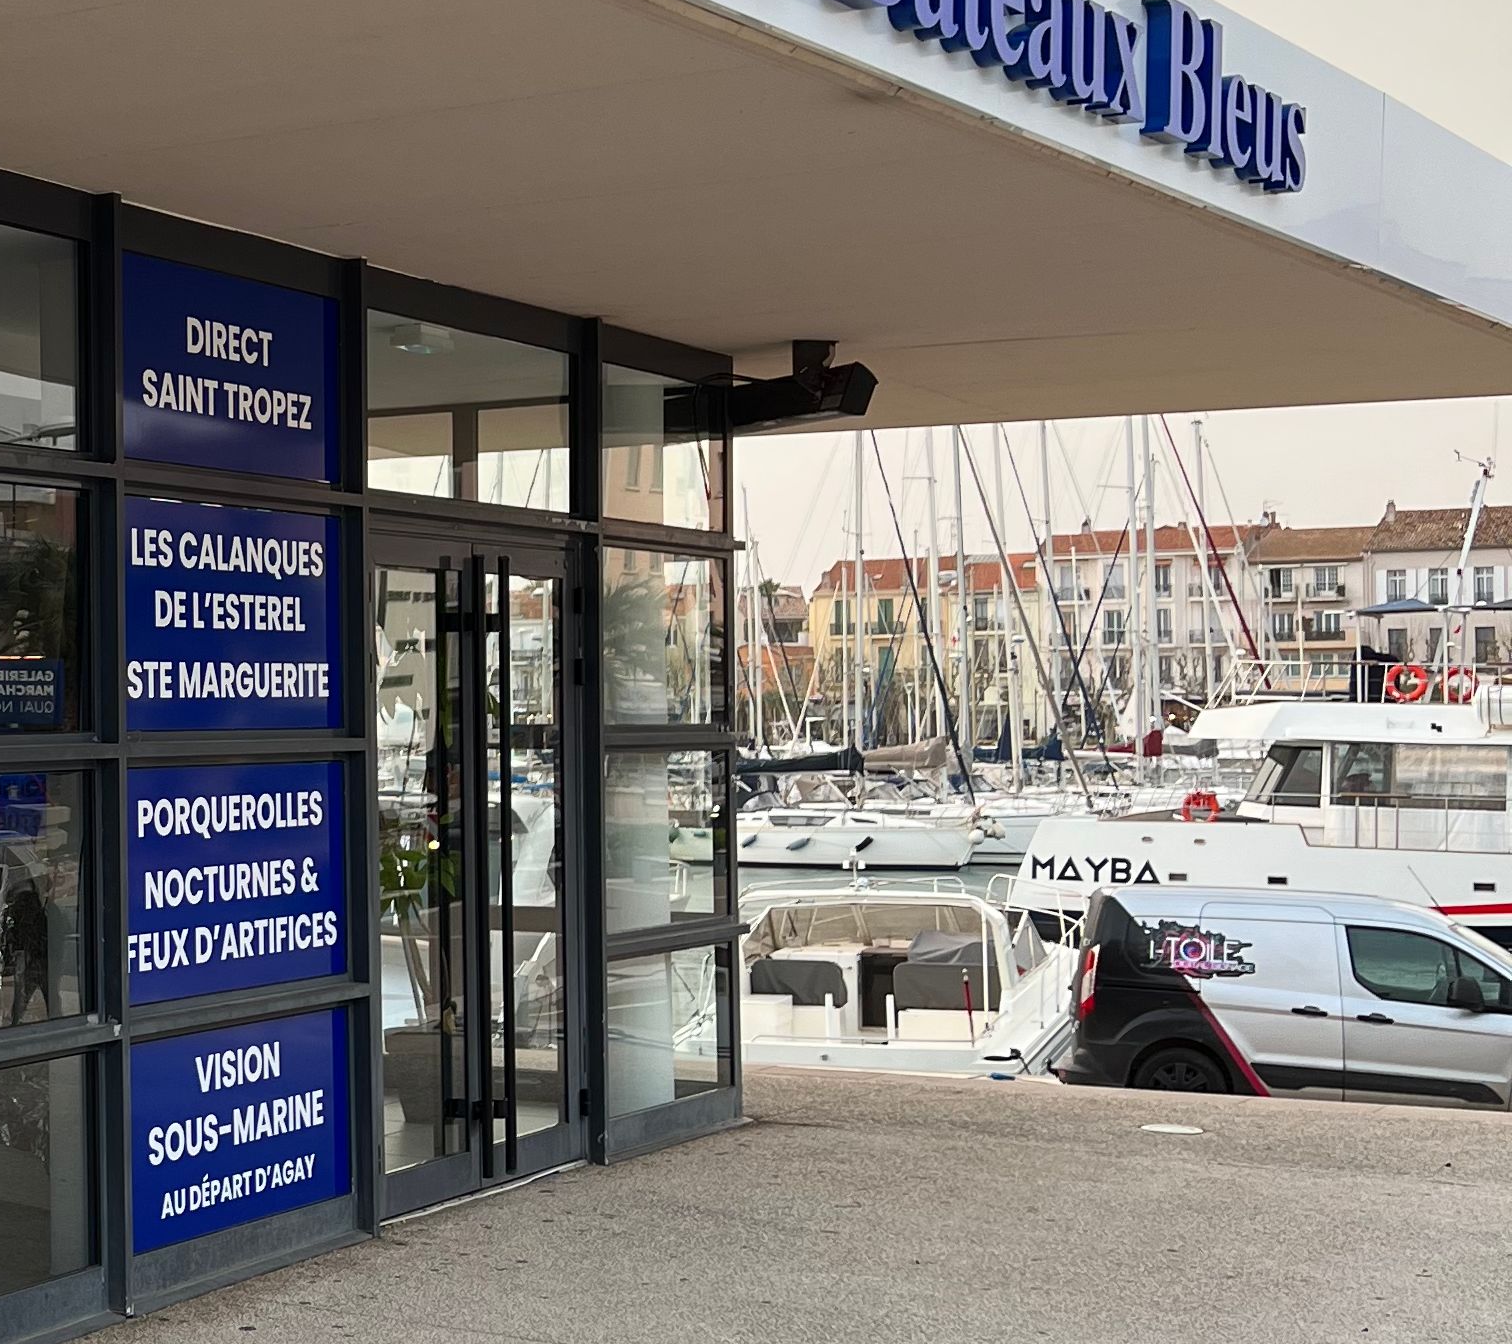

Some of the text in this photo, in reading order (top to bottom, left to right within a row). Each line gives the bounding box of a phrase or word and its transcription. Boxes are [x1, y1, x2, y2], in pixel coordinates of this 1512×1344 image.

[186, 316, 273, 367] DIRECT
[142, 369, 312, 430] SAINT TROPEZ
[131, 527, 323, 579] LES CALANQUES
[155, 590, 305, 632] DE L'ESTEREL
[127, 660, 329, 699] STE MARGUERITE
[137, 790, 323, 839] PORQUEROLLES
[144, 857, 319, 910] NOCTURNES &
[1031, 854, 1161, 885] MAYBA
[127, 911, 338, 974] FEUX D'ARTIFICES
[195, 1041, 281, 1093] VISION
[148, 1089, 324, 1166] SOUS-MARINE
[161, 1154, 316, 1220] AU DÉPART D'AGAY
